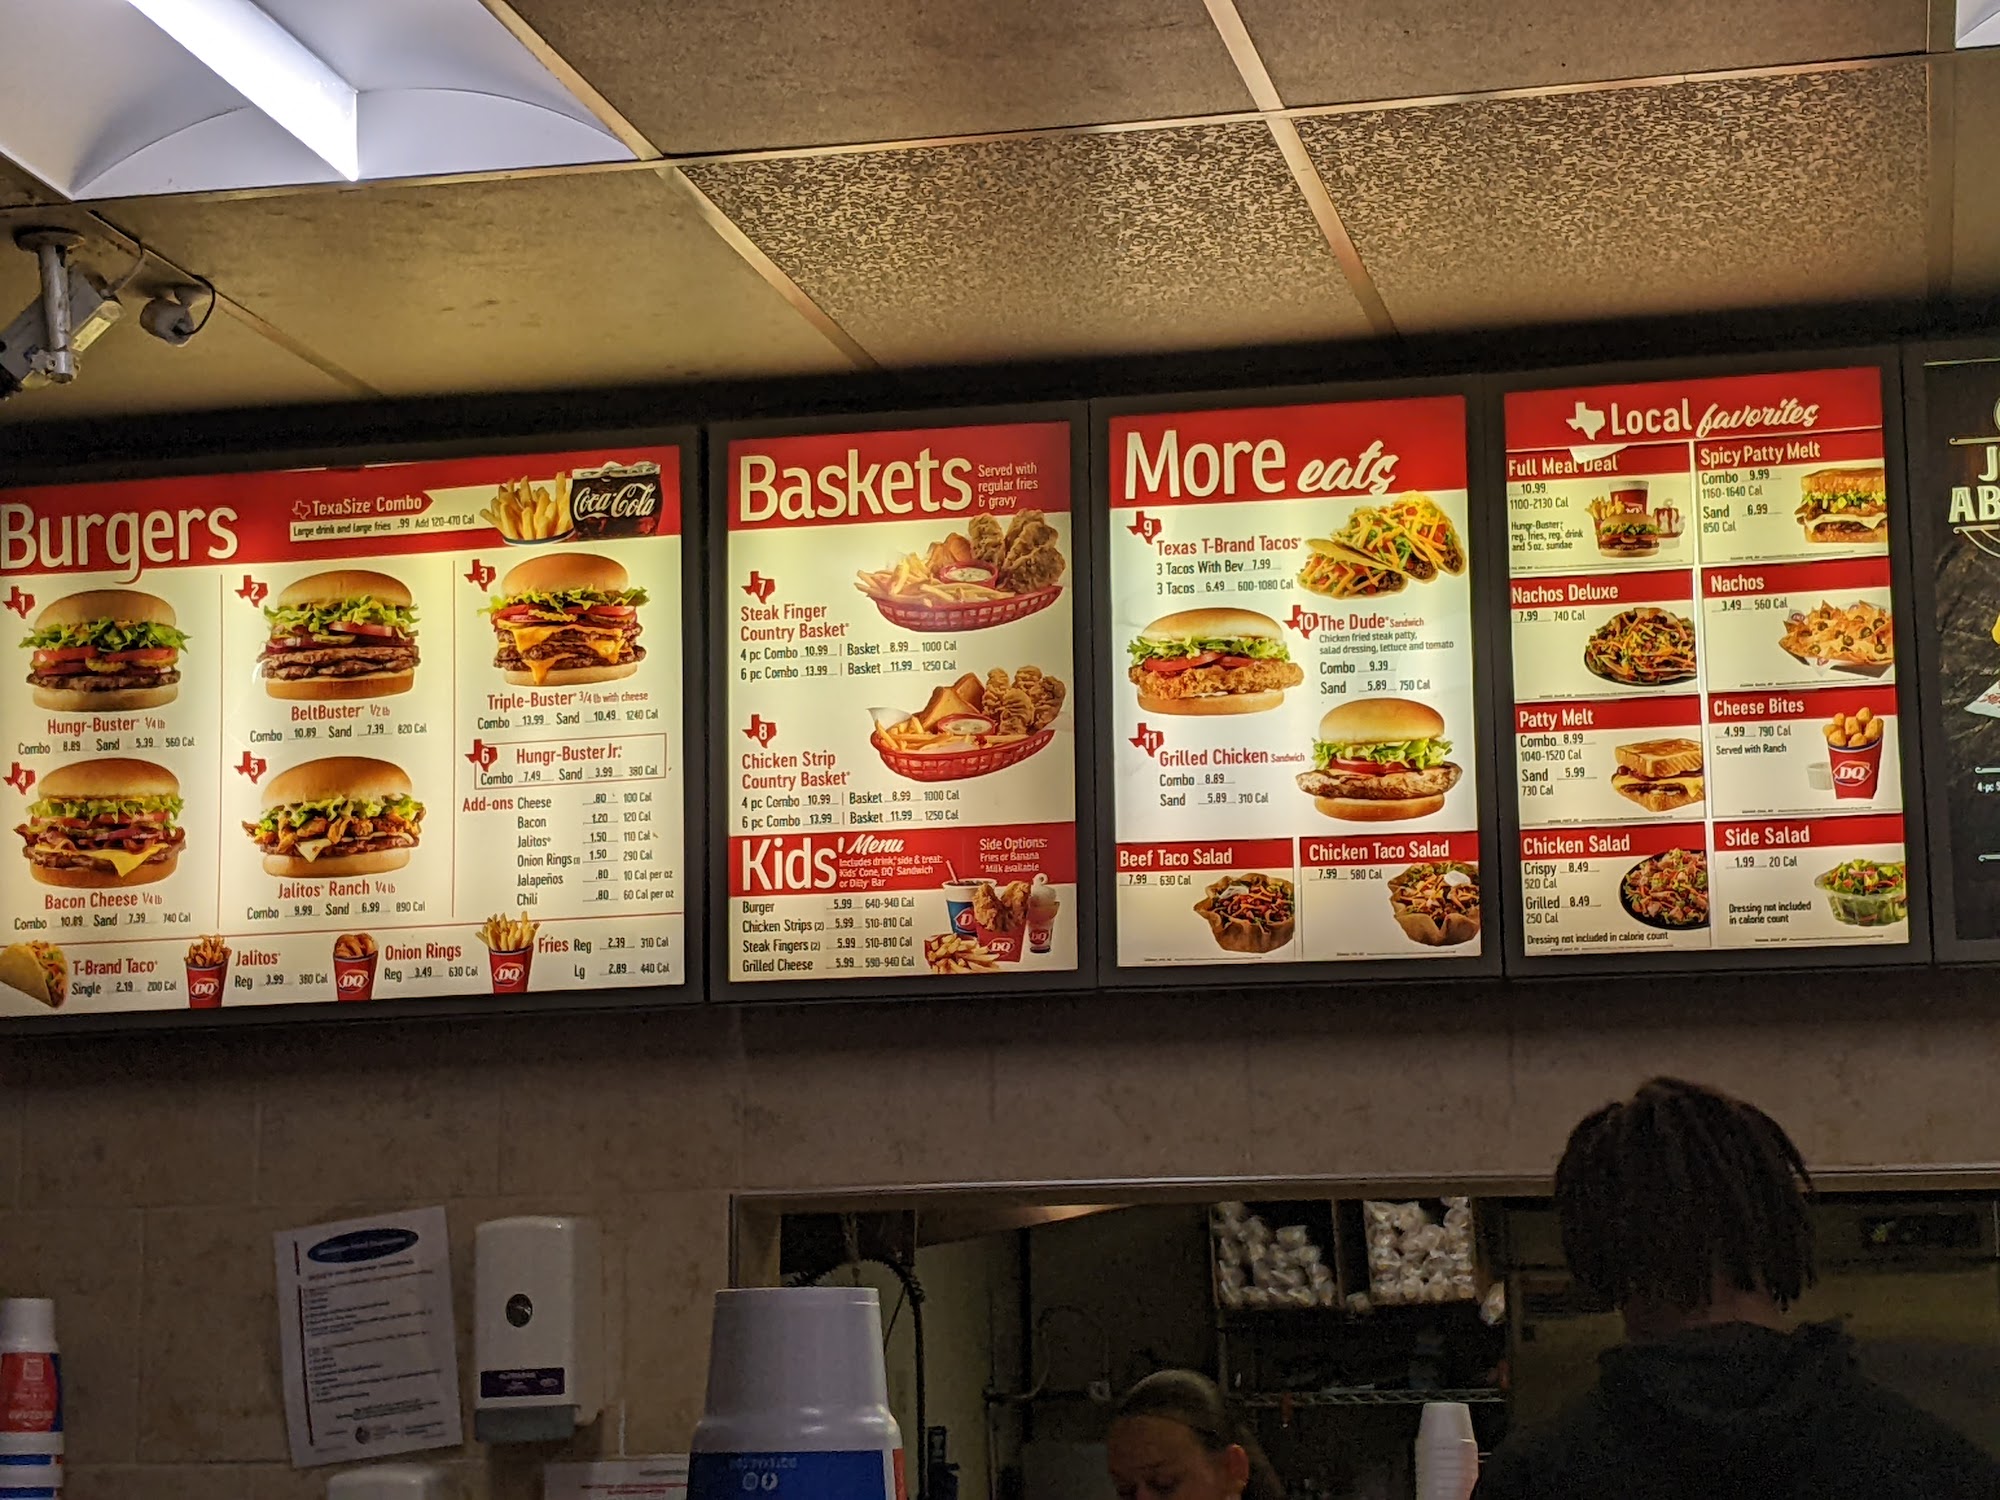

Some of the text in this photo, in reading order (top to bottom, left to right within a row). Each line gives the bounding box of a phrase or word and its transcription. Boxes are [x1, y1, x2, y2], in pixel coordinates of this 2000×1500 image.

[1611, 398, 1819, 438] Local favorites
[1701, 442, 1820, 468] Spicy Patty Melt
[978, 462, 1037, 478] Served with
[1125, 429, 1399, 499] More eats
[1509, 459, 1537, 476] Full
[1542, 458, 1579, 474] Meal
[1750, 469, 1769, 480] 9.99
[740, 448, 972, 522] Baskets
[978, 477, 1038, 492] regular fries
[1522, 483, 1545, 493] 10.99
[313, 495, 422, 516] TexaSize Combo
[979, 495, 1017, 509] & gravy
[294, 521, 391, 537] Large drink and large fries
[1144, 520, 1152, 536] 9
[1, 503, 238, 584] Burgers
[1157, 536, 1298, 555] Texas T-Brand Tacos
[1157, 559, 1270, 575] 3 Tacos With Bev 7.99
[759, 580, 765, 596] 7
[1711, 574, 1764, 592] Nachos
[1512, 583, 1618, 604] Nachos Deluxe
[741, 604, 827, 622] Steak Finger
[1298, 614, 1314, 630] 10
[1320, 613, 1424, 630] The Dude Sandwich
[741, 623, 845, 642] Country Basket
[1320, 631, 1417, 643] Chicken fried steak patty,
[741, 645, 828, 662] 4 pc 10.99
[848, 641, 957, 656] Basket 8.99 Cal
[1320, 641, 1454, 654] salad dressing, lettuce and tomato
[1369, 661, 1388, 671] 9.39
[1368, 680, 1430, 690] 5.89 750 Cal
[488, 692, 648, 712] Triple-Buster cheese
[1714, 698, 1805, 716] Cheese Bites
[292, 705, 361, 721] BeltBuster
[478, 711, 616, 730] Combo 13.99 Sand 10.49
[1520, 709, 1594, 730] Patty Melt
[48, 718, 136, 737] Hungr-Buster
[250, 726, 352, 742] Combo Sand
[759, 724, 767, 740] 8
[1724, 726, 1745, 737] 4.99
[18, 738, 119, 755] Combo Sand
[1143, 733, 1157, 749] 11
[1564, 734, 1583, 744] 8.99
[481, 749, 489, 764] 6
[517, 745, 606, 766] Hungr-Buster
[1160, 748, 1268, 767] Grilled Chicken
[1521, 750, 1565, 762] 1040-1520
[1716, 744, 1786, 755] Served with Ranch
[742, 750, 835, 769] Chicken Strip
[481, 767, 613, 785] Combo Sand 3.99
[1839, 767, 1865, 780] DQ
[463, 797, 551, 812] Add-ons Cheese
[518, 817, 546, 828] Bacon
[518, 835, 547, 848] Jalitos
[1589, 834, 1630, 852] Salad
[1726, 825, 1810, 846] Side Salad
[980, 837, 1047, 852] Side Options:
[1309, 840, 1449, 861] Chicken Taco Salad
[518, 854, 572, 868] Onion Rings
[742, 834, 904, 891] Kids' Menu
[1120, 848, 1232, 867] Beef Taco Salad
[1735, 857, 1780, 867] 1.99 20
[1351, 869, 1382, 879] 580 Cal
[1524, 862, 1588, 877] Crispy 8.49
[517, 872, 563, 888] Jalapeños
[278, 880, 369, 899] Jalitos Ranch
[45, 892, 138, 910] Bacon Cheese
[517, 893, 538, 906] Chili
[743, 899, 852, 915] Burger 5.99
[1526, 895, 1560, 910] Grilled
[248, 903, 349, 920] Combo Sand
[14, 914, 117, 930] Combo Sand
[743, 918, 853, 933] Chicken Strips 5.99
[539, 935, 591, 953] Fries Reg
[743, 939, 808, 953] Steak Fingers
[1527, 931, 1668, 945] Dressing not included in calorie count
[235, 950, 277, 966] Jalitos
[386, 943, 461, 960] Onion Rings
[73, 959, 153, 975] T-Brand Taco
[575, 965, 585, 979] Lg
[743, 958, 813, 972] Grilled Cheese
[72, 982, 101, 997] Single
